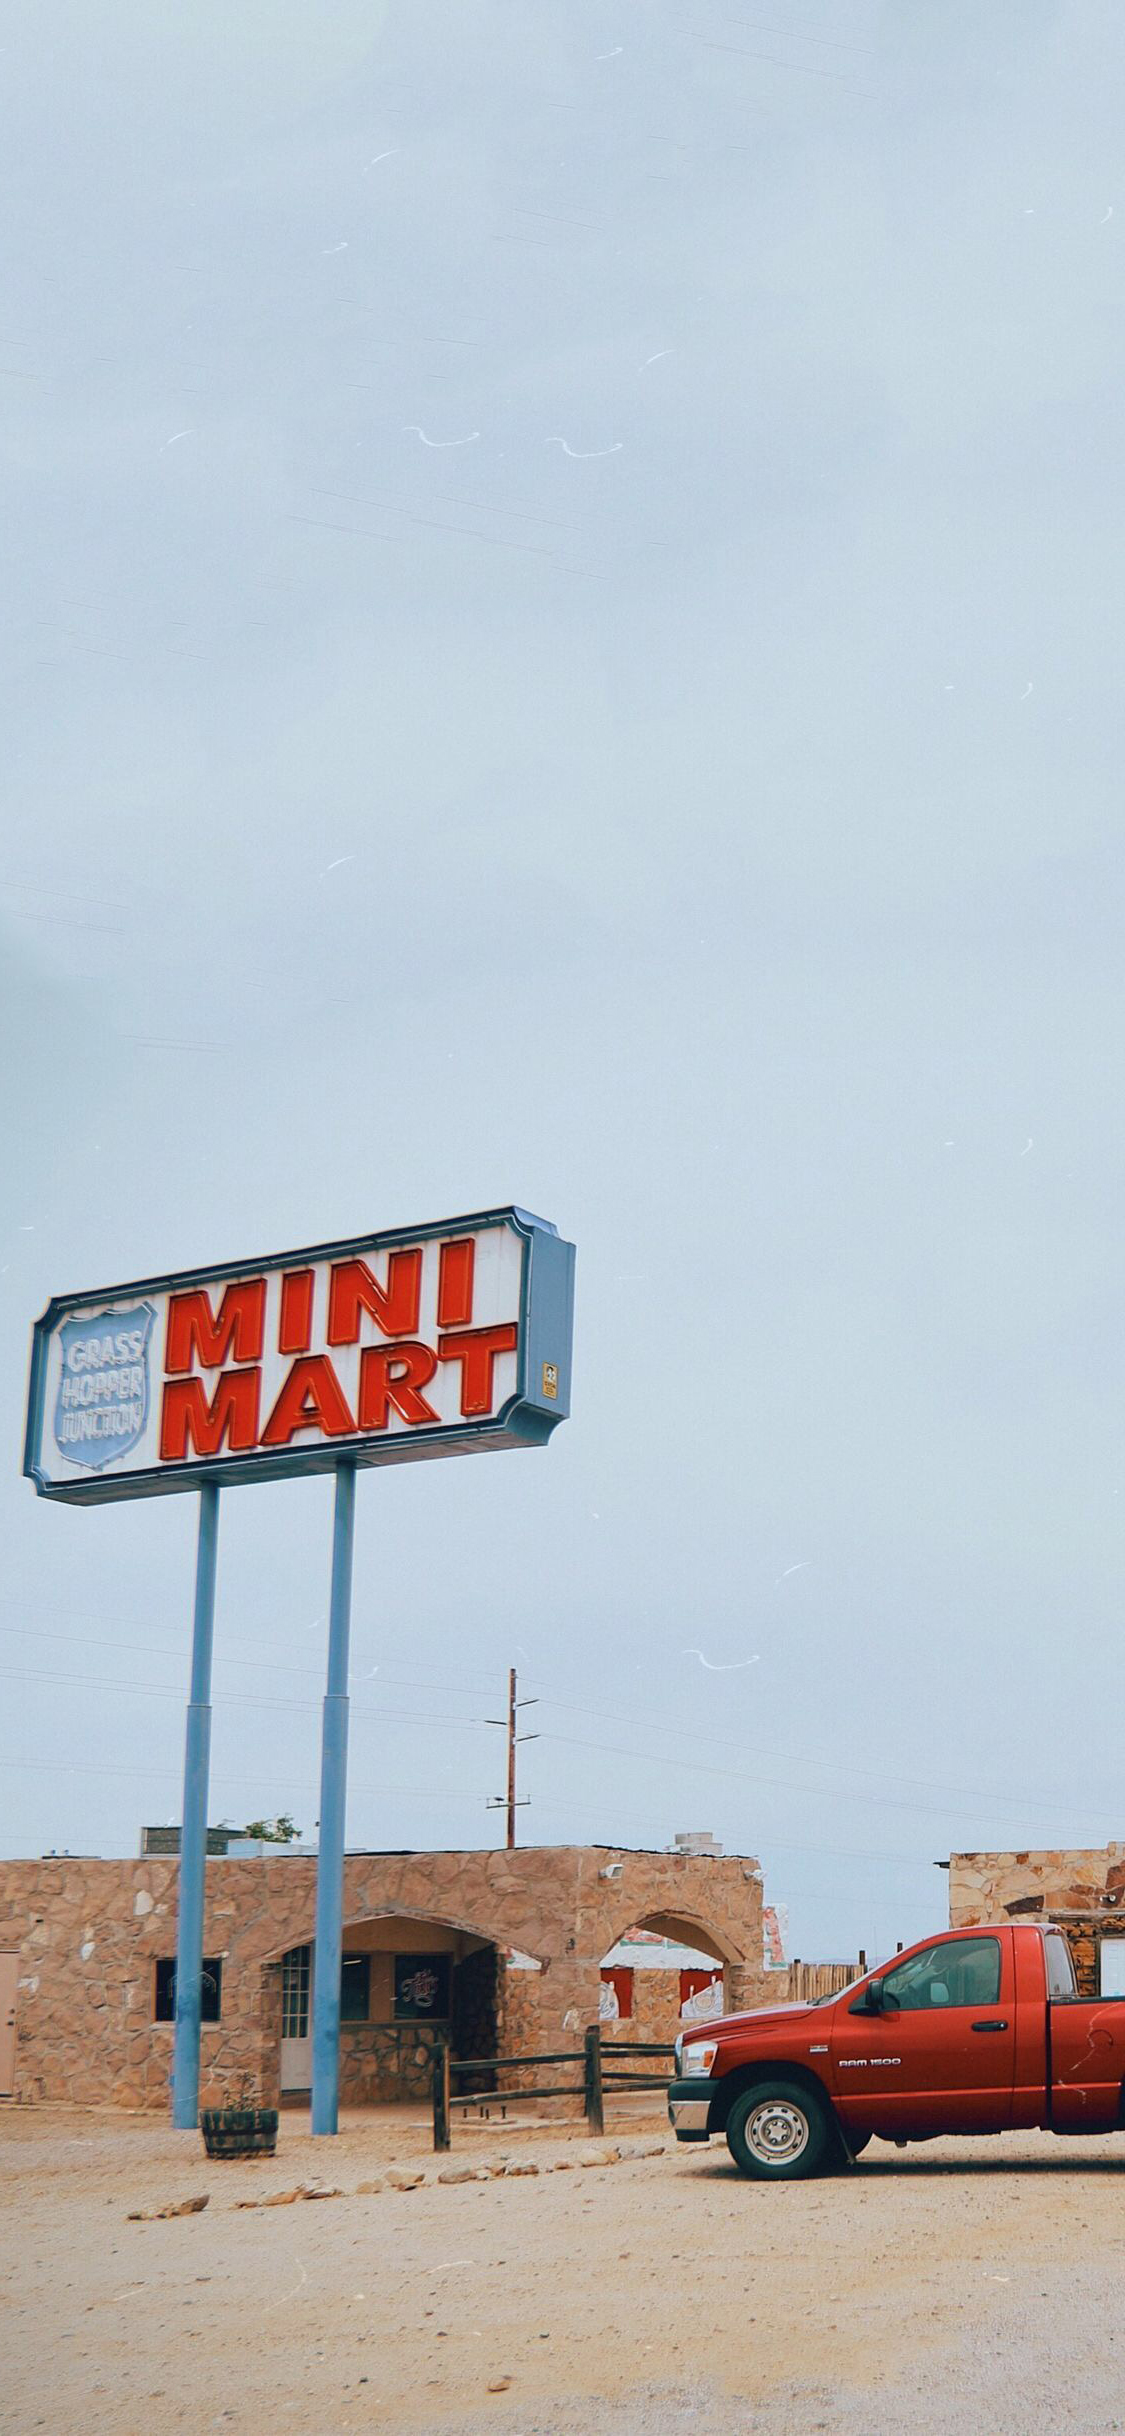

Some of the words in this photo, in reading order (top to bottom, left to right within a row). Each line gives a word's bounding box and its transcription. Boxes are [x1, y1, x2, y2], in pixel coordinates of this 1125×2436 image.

[165, 1237, 475, 1374] MINI
[67, 1330, 143, 1373] GRASS
[61, 1366, 143, 1408] HOPPER
[159, 1321, 518, 1461] MART
[57, 1401, 143, 1444] JUNCTION
[838, 2059, 868, 2067] RAM
[869, 2057, 902, 2066] 1500
